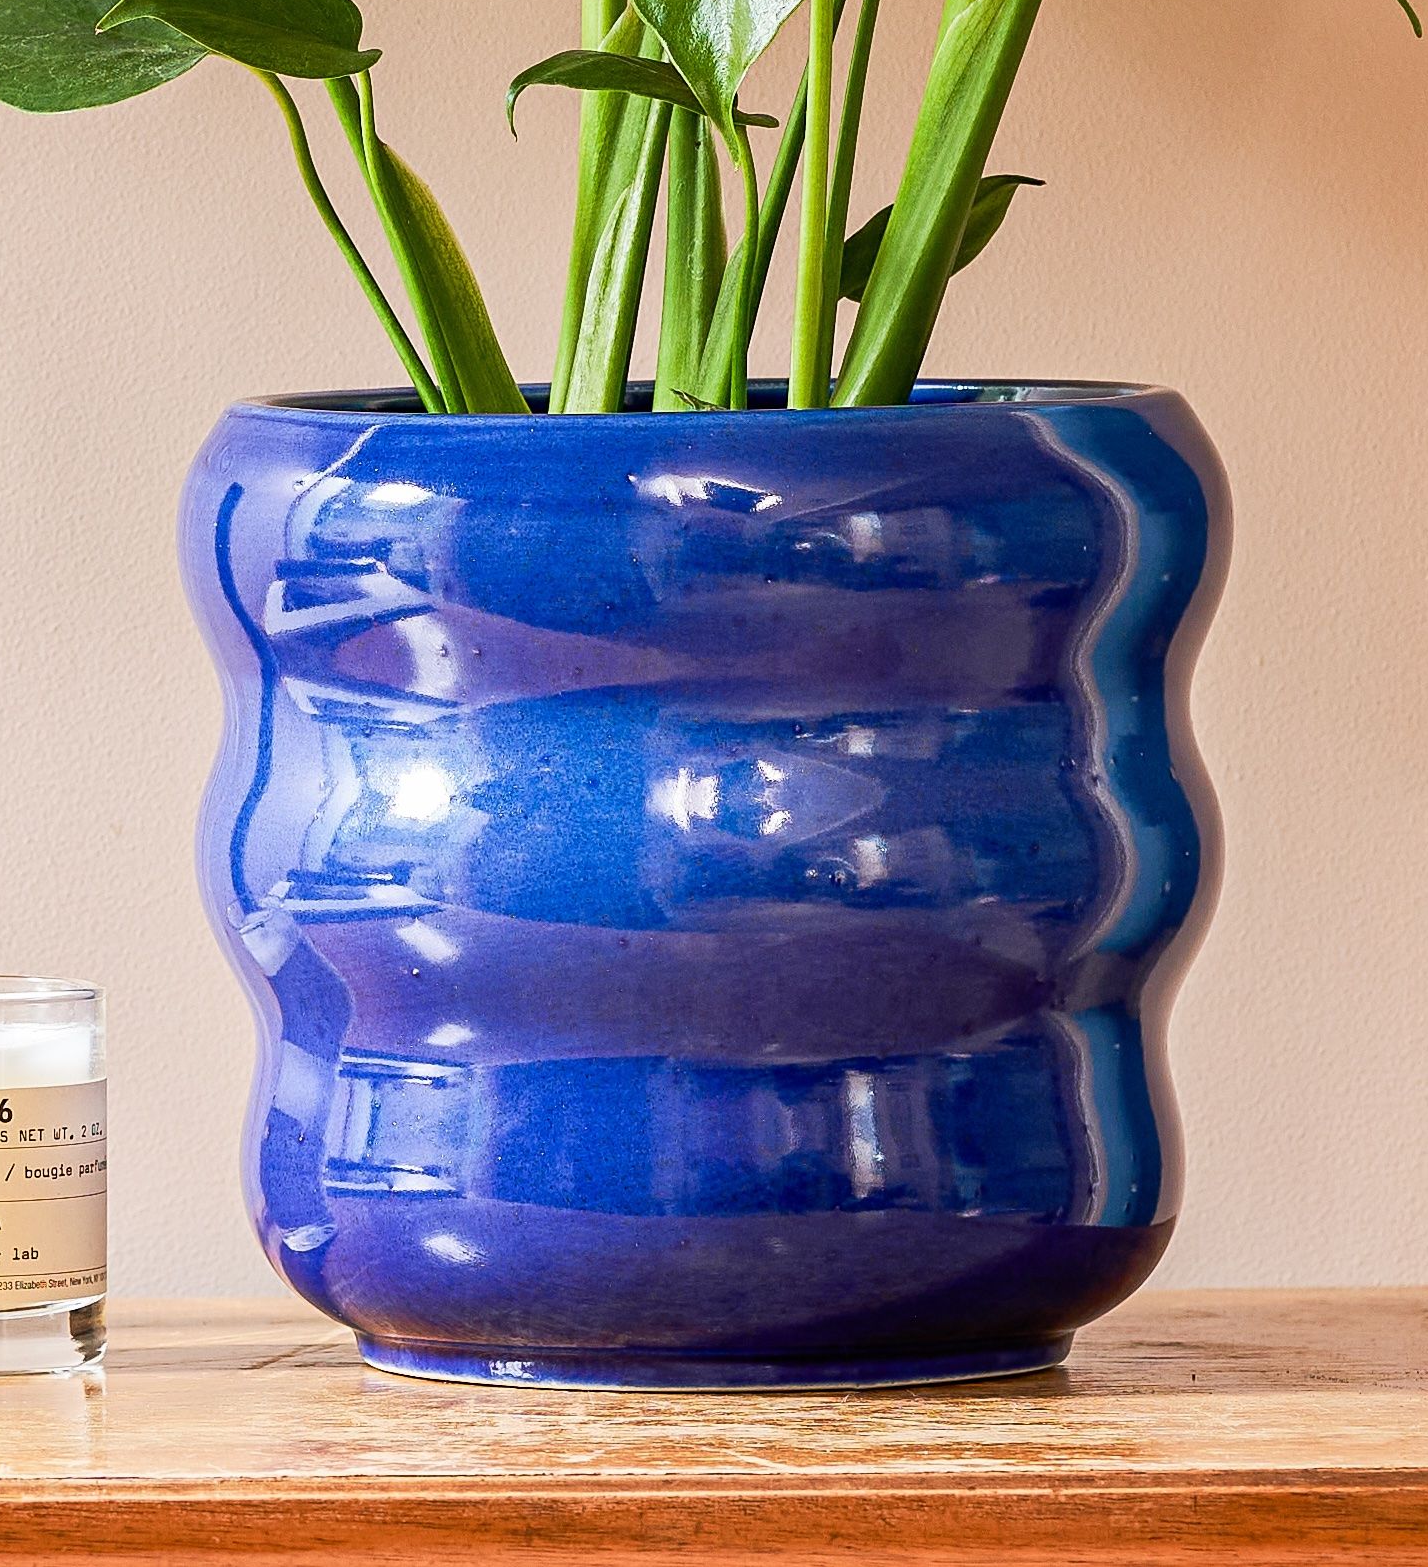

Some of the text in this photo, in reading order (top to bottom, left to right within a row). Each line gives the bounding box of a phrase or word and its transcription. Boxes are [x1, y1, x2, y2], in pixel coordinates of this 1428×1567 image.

[19, 1128, 45, 1143] NET
[53, 1126, 74, 1140] WT.
[81, 1125, 87, 1138] 2
[25, 1163, 73, 1180] bougie
[12, 1247, 39, 1261] lab
[15, 1279, 47, 1290] Elizabeth
[48, 1278, 69, 1289] Street,
[69, 1277, 81, 1286] New
